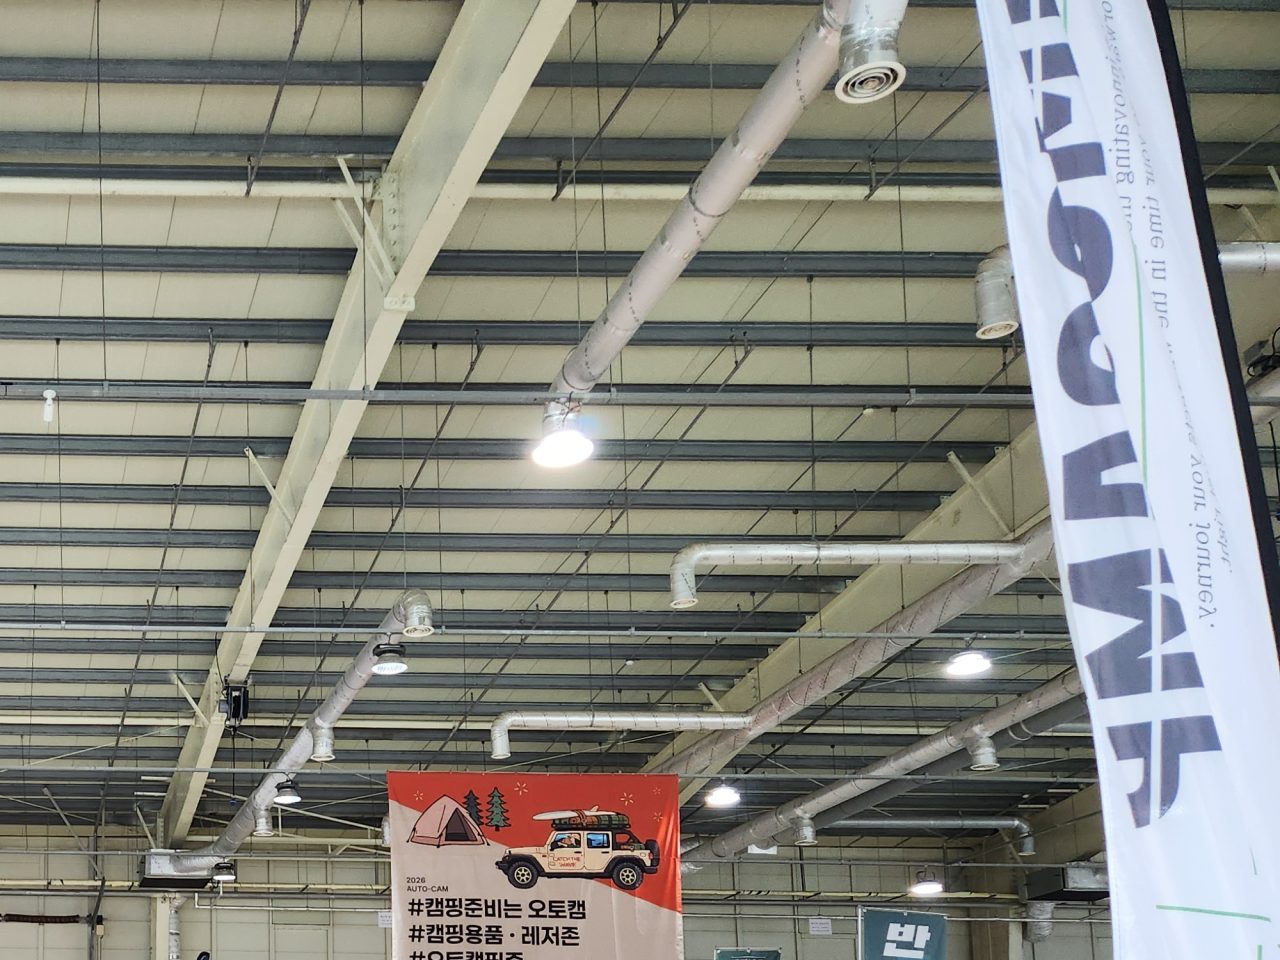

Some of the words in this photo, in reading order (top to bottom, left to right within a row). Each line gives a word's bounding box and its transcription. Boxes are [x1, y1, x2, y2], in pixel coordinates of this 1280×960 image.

[407, 897, 523, 919] #캠핑준비는
[527, 899, 587, 920] 오토캠
[408, 923, 505, 945] #캠핑용품
[521, 925, 581, 947] 레저존
